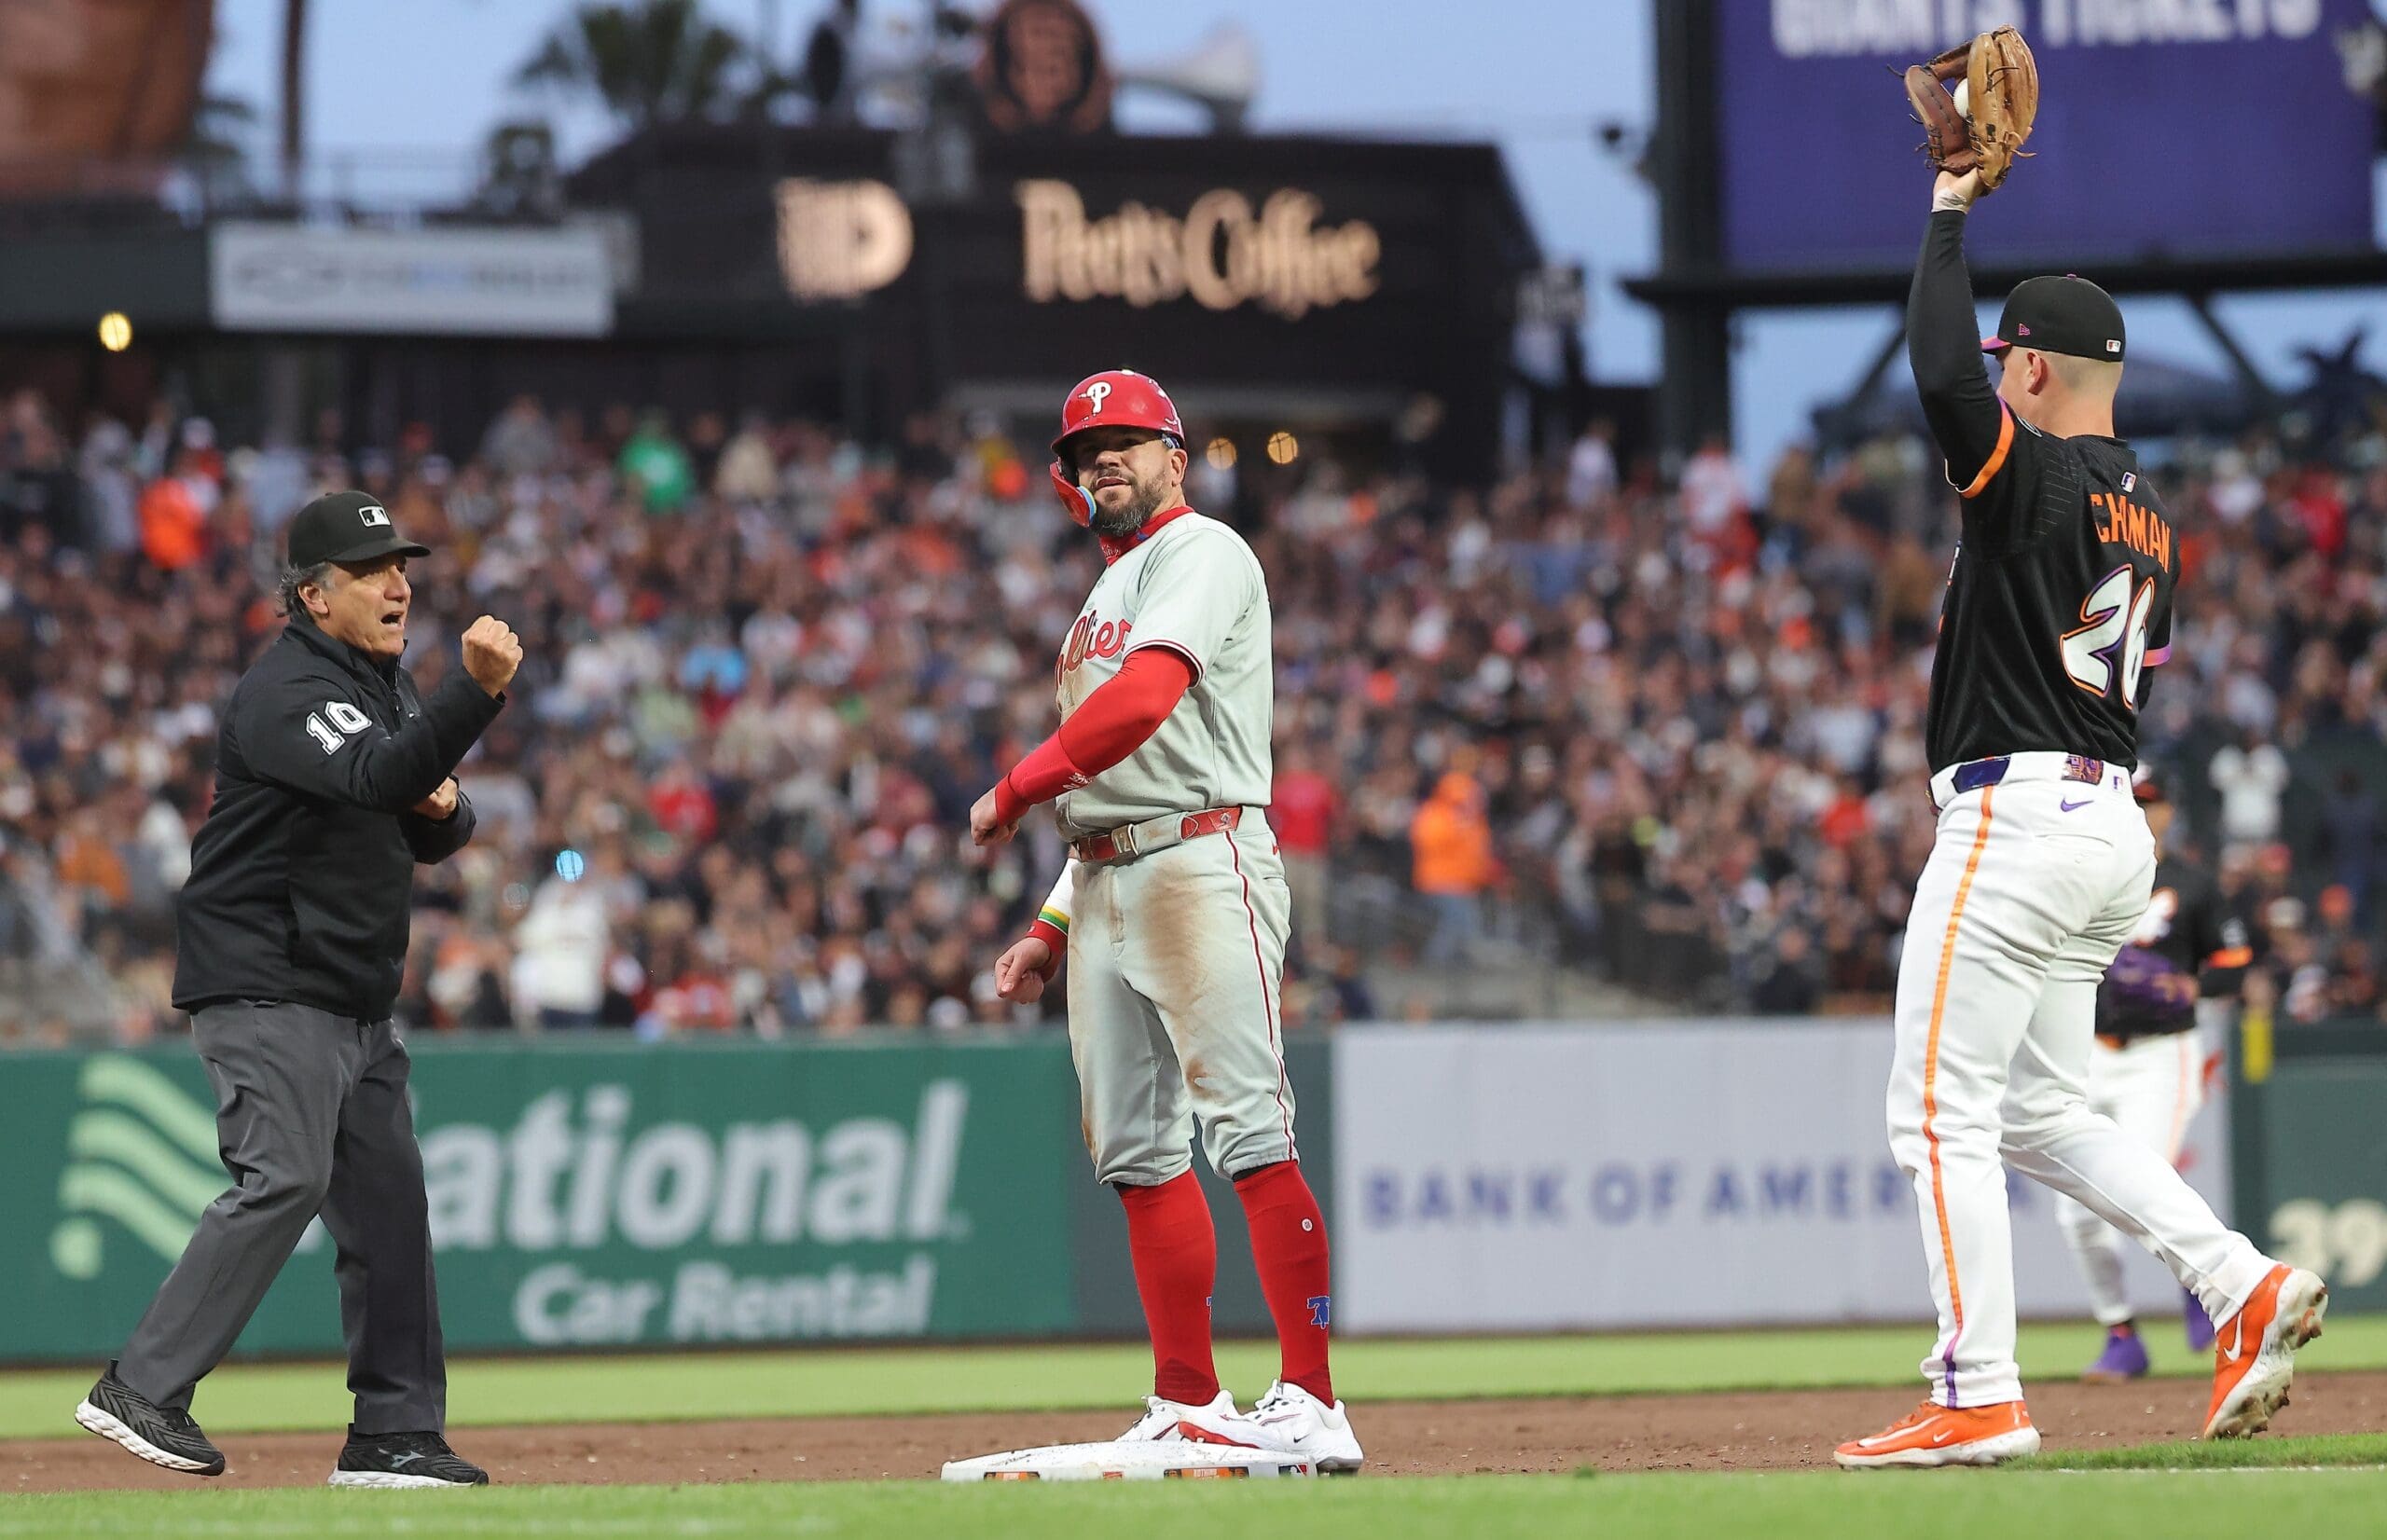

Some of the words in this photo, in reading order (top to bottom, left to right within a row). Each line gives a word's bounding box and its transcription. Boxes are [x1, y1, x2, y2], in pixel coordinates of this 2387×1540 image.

[1182, 187, 1381, 321] Coffee
[1078, 380, 1112, 416] P
[2059, 563, 2156, 710] 26
[305, 701, 373, 756] 10
[295, 1079, 968, 1251] ational
[1361, 1168, 1568, 1227] BANK
[1587, 1163, 1678, 1225] OF
[515, 1262, 662, 1344] Car
[668, 1251, 935, 1341] Rental
